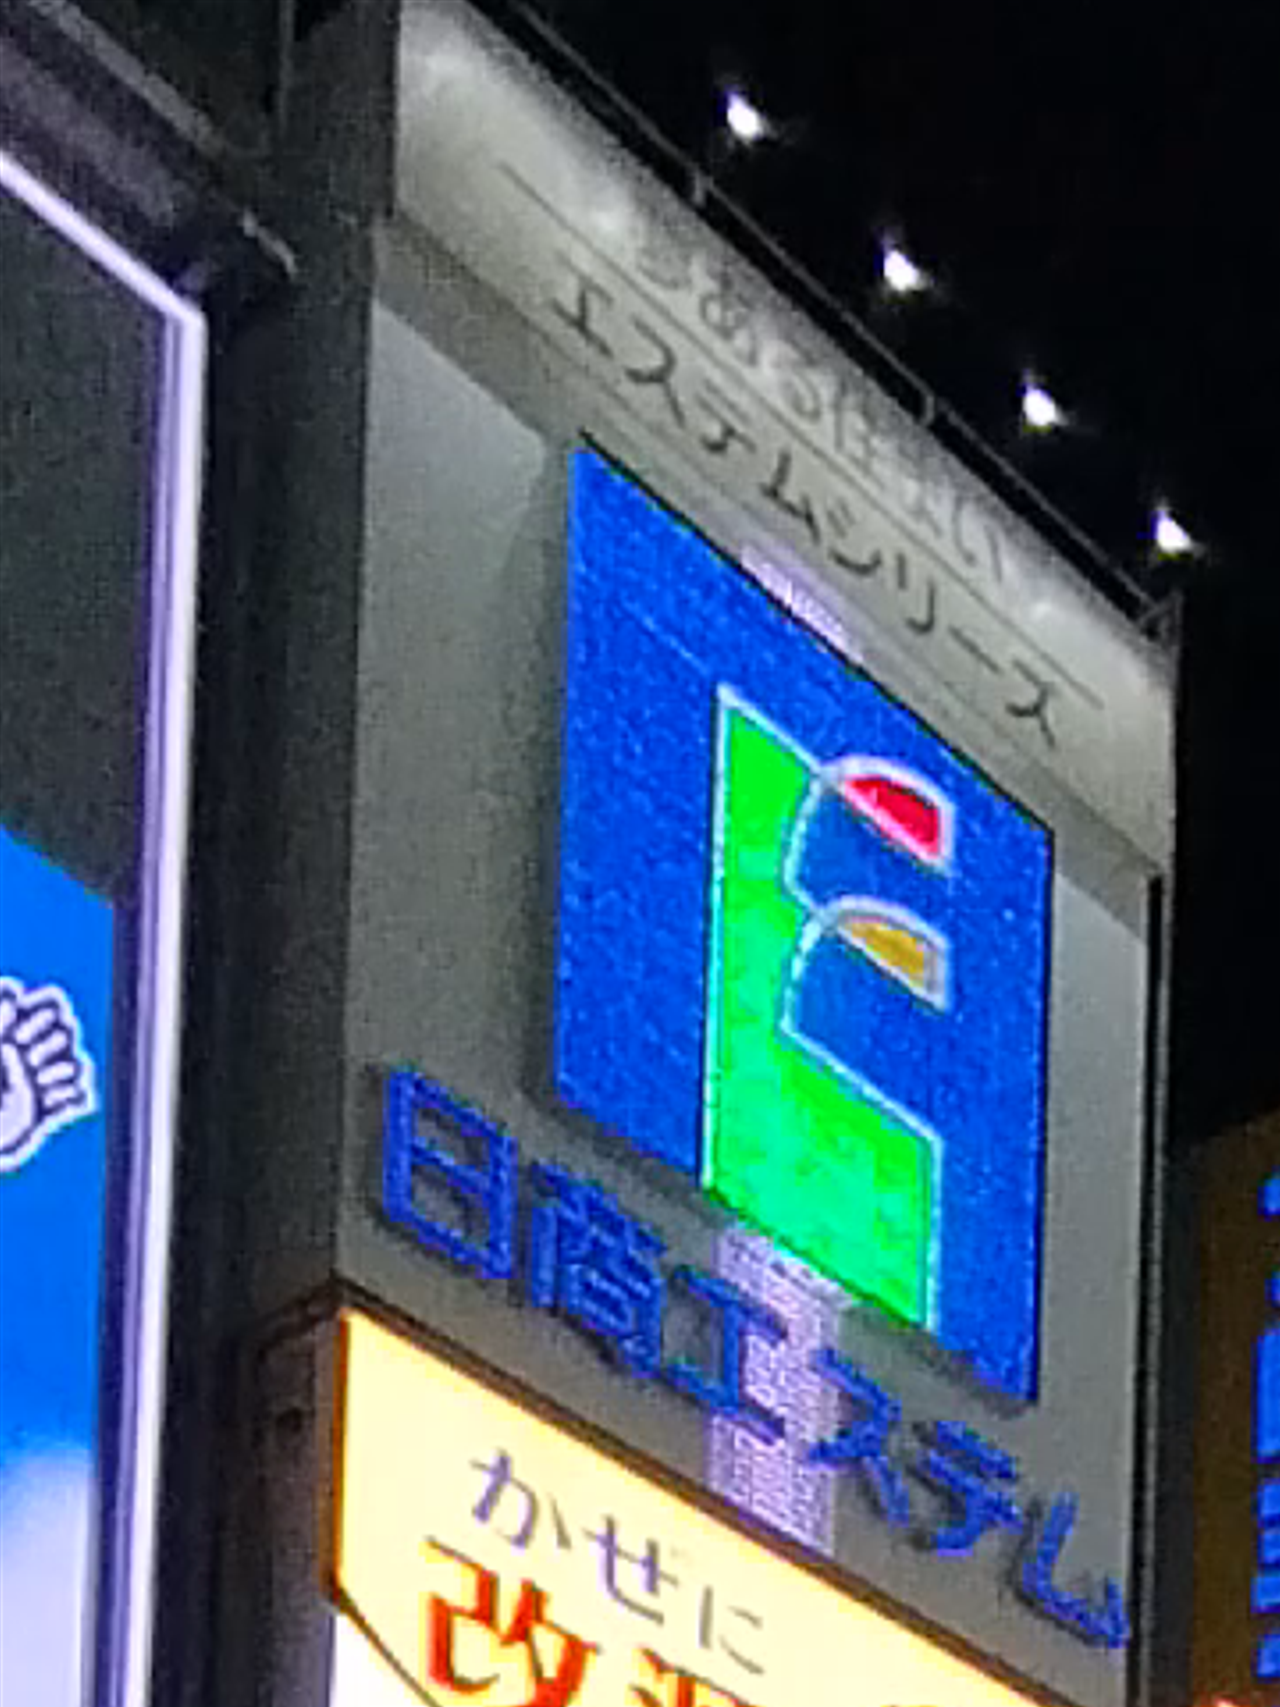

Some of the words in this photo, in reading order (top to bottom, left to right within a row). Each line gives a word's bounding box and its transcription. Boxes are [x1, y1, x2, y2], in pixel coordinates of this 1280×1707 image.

[380, 1066, 1130, 1648] 日商エステム
